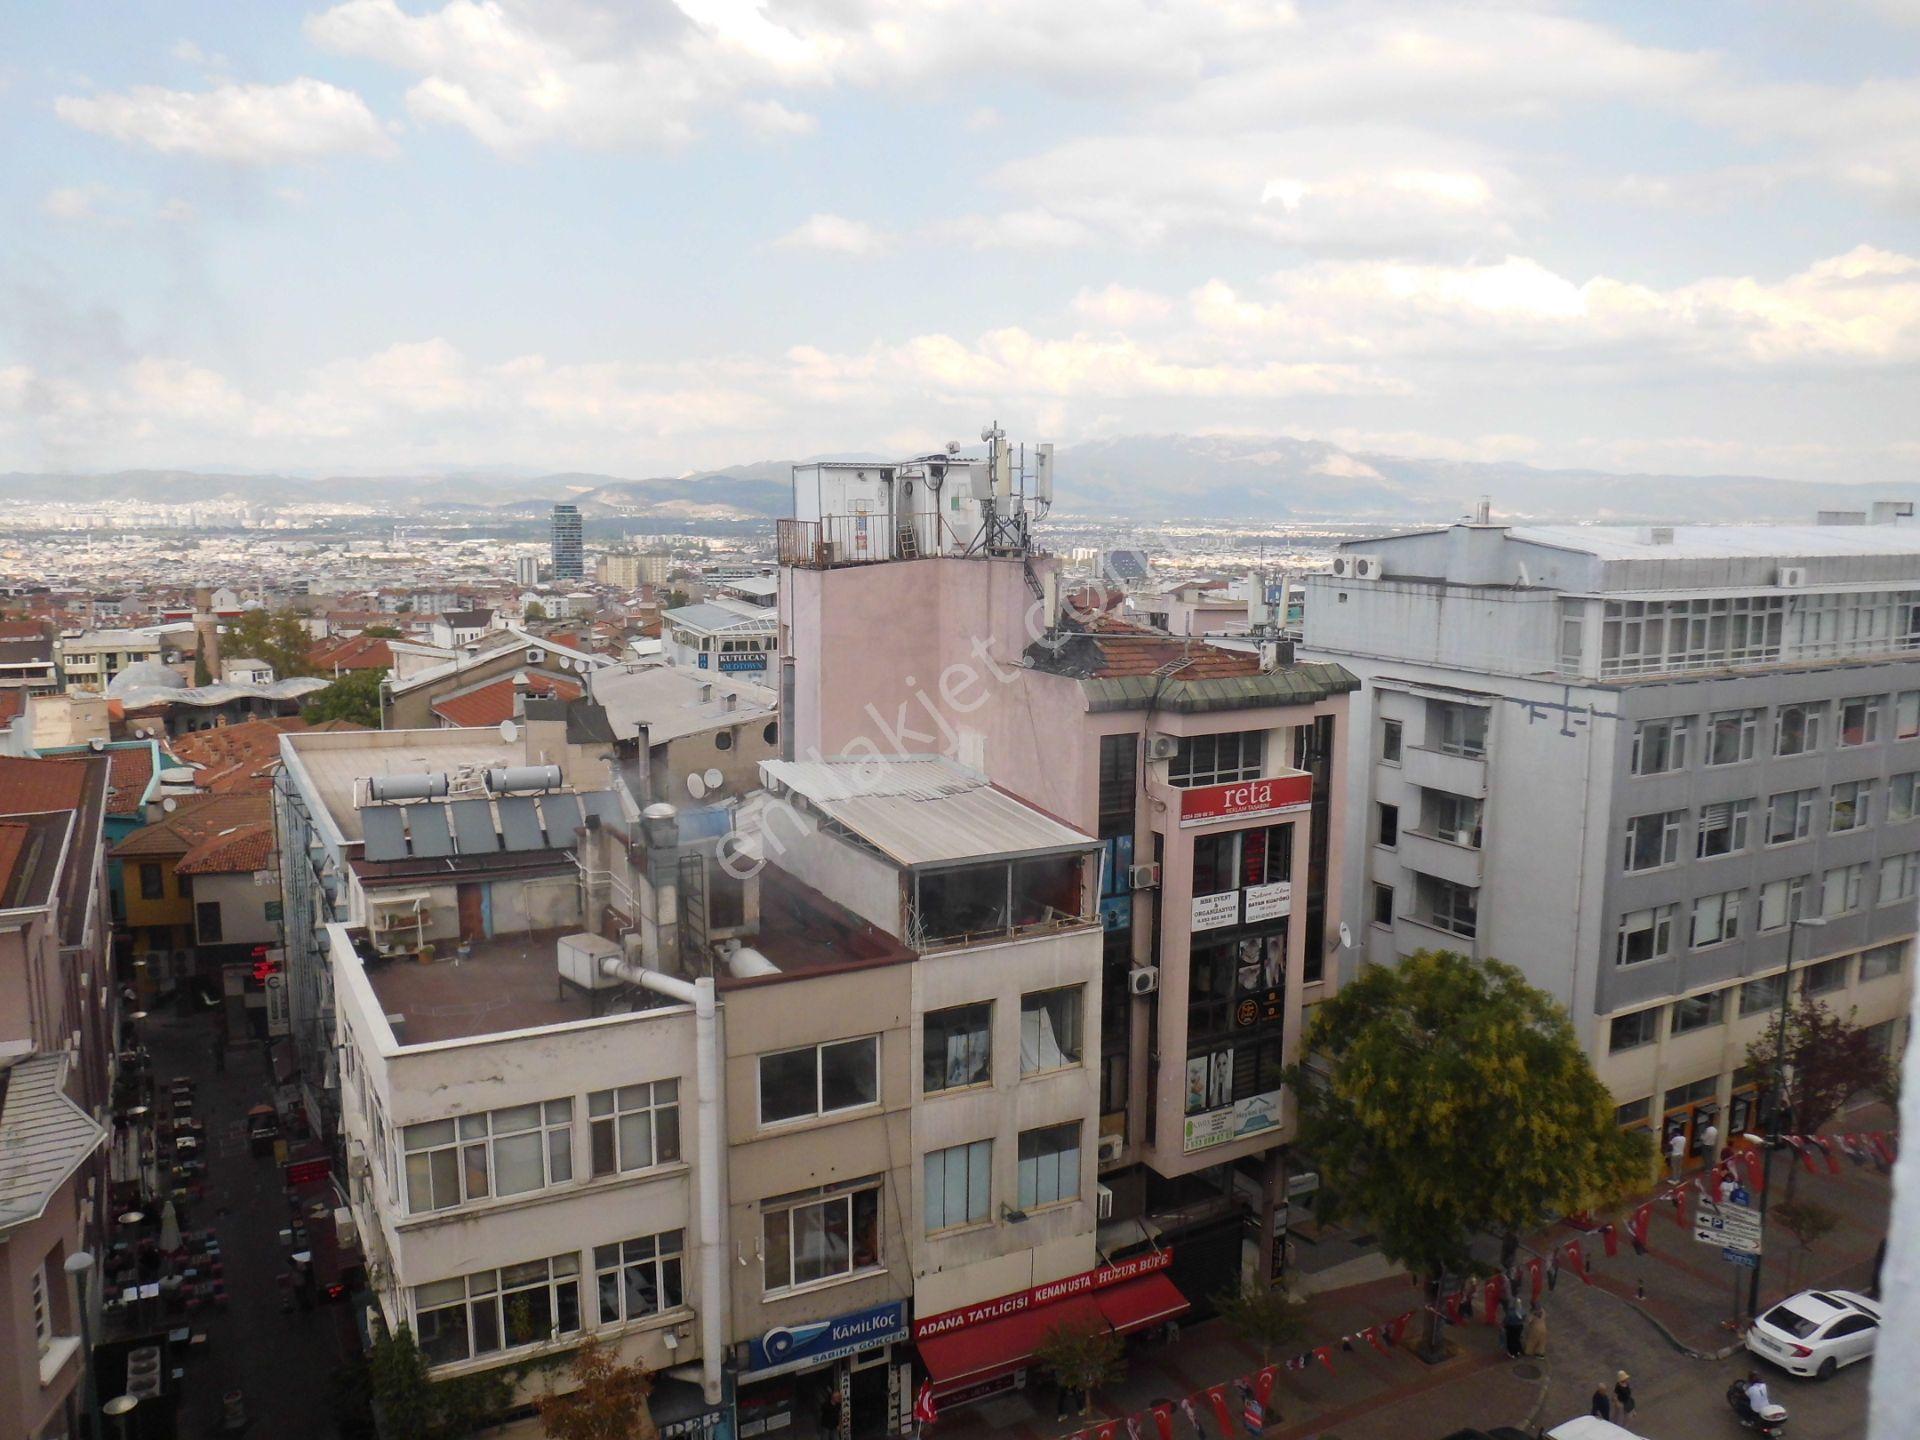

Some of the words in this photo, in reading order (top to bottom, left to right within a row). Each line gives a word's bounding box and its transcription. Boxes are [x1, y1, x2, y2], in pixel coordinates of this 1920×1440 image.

[720, 654, 766, 662] KUTLUCAN
[1223, 782, 1272, 808] reta
[1099, 1263, 1137, 1283] HUZUR
[919, 1315, 964, 1336] ADANA
[968, 1297, 1028, 1323] TATLICISI
[1035, 1283, 1067, 1301] KENAN
[1068, 1276, 1091, 1292] USTA
